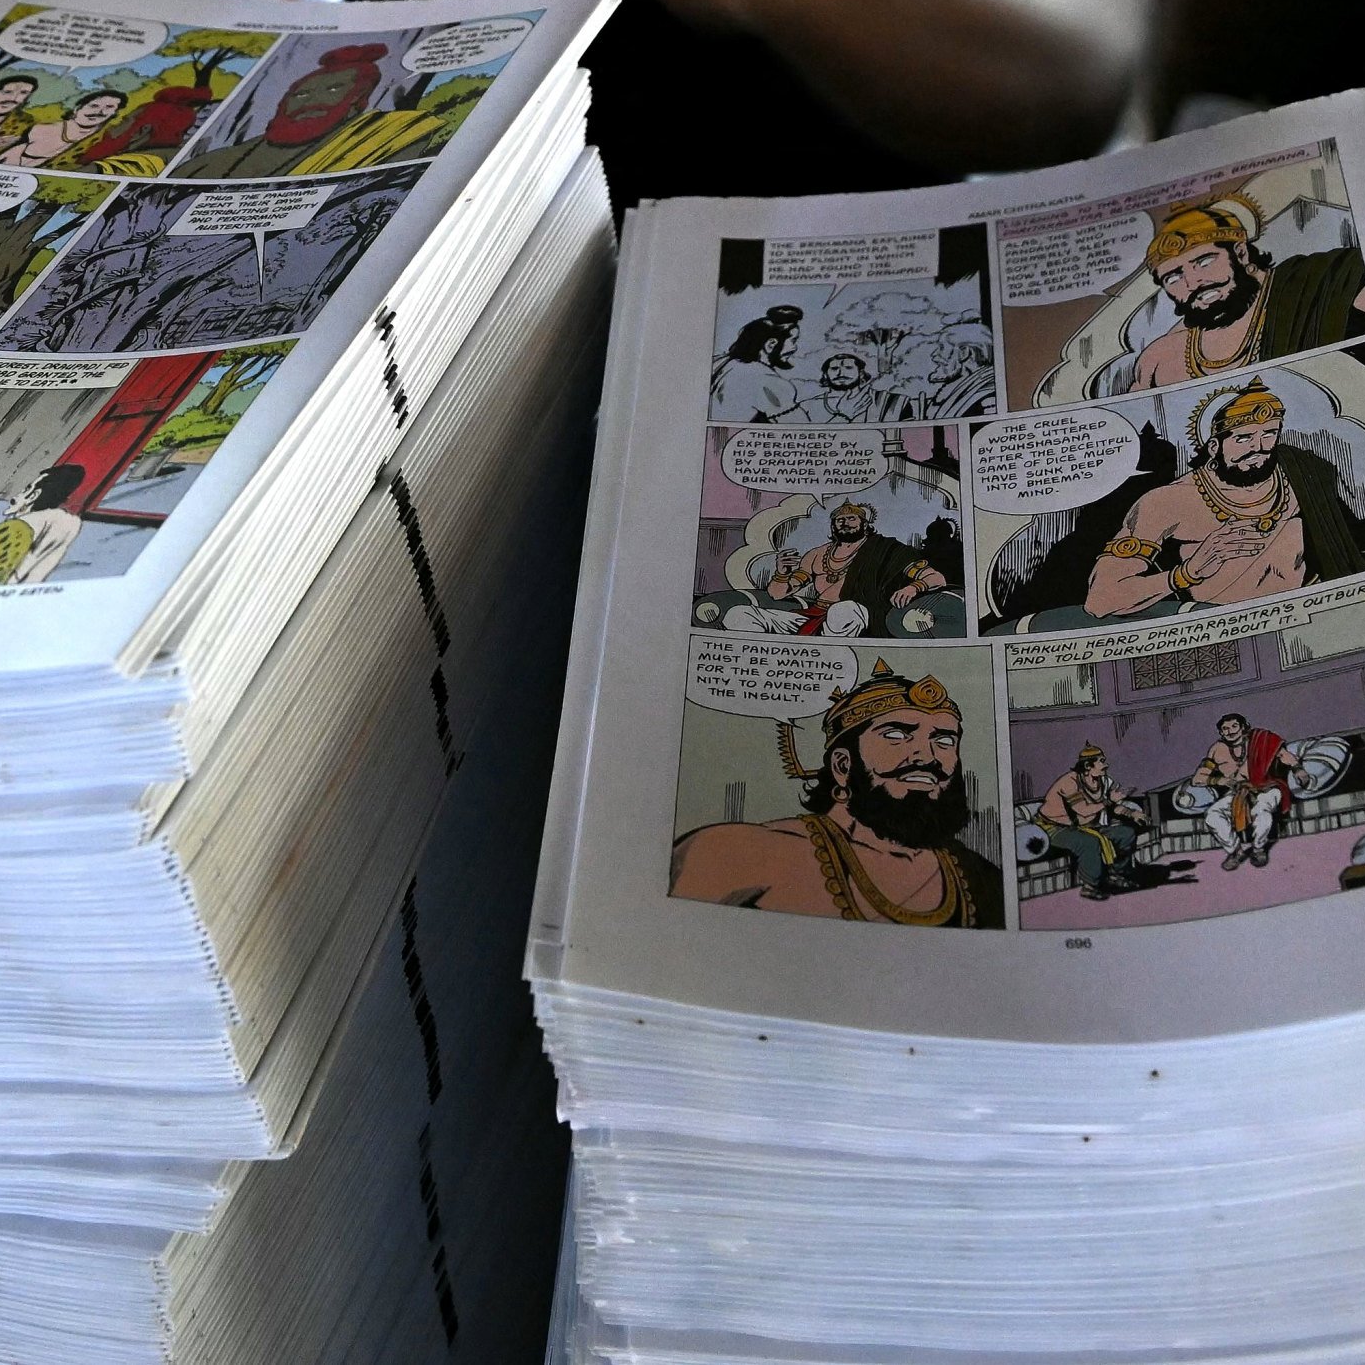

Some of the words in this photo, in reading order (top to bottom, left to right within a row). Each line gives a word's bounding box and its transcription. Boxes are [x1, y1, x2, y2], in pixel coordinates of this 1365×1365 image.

[263, 189, 318, 199] PANDAVAS
[190, 207, 269, 215] DISTRIBUTING
[272, 202, 318, 213] CHARITY
[217, 213, 288, 222] PERFORMING
[989, 433, 1035, 444] WORDS
[1043, 420, 1107, 436] UTTERED
[1002, 424, 1027, 434] THE
[1034, 417, 1078, 429] CRUEL
[737, 440, 833, 449] EXPERIENCED
[978, 447, 993, 455] BY
[1001, 433, 1091, 453] DUHSHASANA
[979, 452, 1023, 464] AFTER
[1030, 448, 1055, 458] THE
[1061, 436, 1132, 454] DECEITFUL
[759, 459, 828, 467] DRAUPADI
[836, 458, 872, 466] MUST
[977, 463, 1016, 474] GAME
[1024, 459, 1040, 468] OF
[1047, 455, 1076, 466] DICE
[1084, 446, 1123, 458] MUST
[823, 468, 876, 476] ARJUNA
[981, 473, 1017, 483] HAVE
[1027, 467, 1063, 477] SUNK
[1071, 459, 1103, 471] DEEP
[987, 483, 1017, 492] INTO
[1027, 471, 1093, 487] BHEEMA'S
[1085, 635, 1139, 649] HEARD
[1147, 603, 1295, 640] DHRITARASHTRA'S
[703, 642, 734, 651] THE
[742, 645, 821, 657] PANDAVAS
[1013, 657, 1045, 666] AND
[1056, 652, 1093, 662] TOLD
[1103, 635, 1210, 657] DURYODHANA
[1219, 620, 1270, 639] ABOUT
[698, 653, 741, 663] MUST
[750, 657, 769, 665] BE
[777, 659, 843, 670] WAITING
[697, 664, 724, 673] FOR
[730, 667, 760, 676] THE
[697, 676, 730, 685] NITY
[739, 679, 757, 688] TO
[764, 681, 821, 691] AVENGE
[708, 687, 735, 697] THE
[1066, 938, 1091, 949] 696
